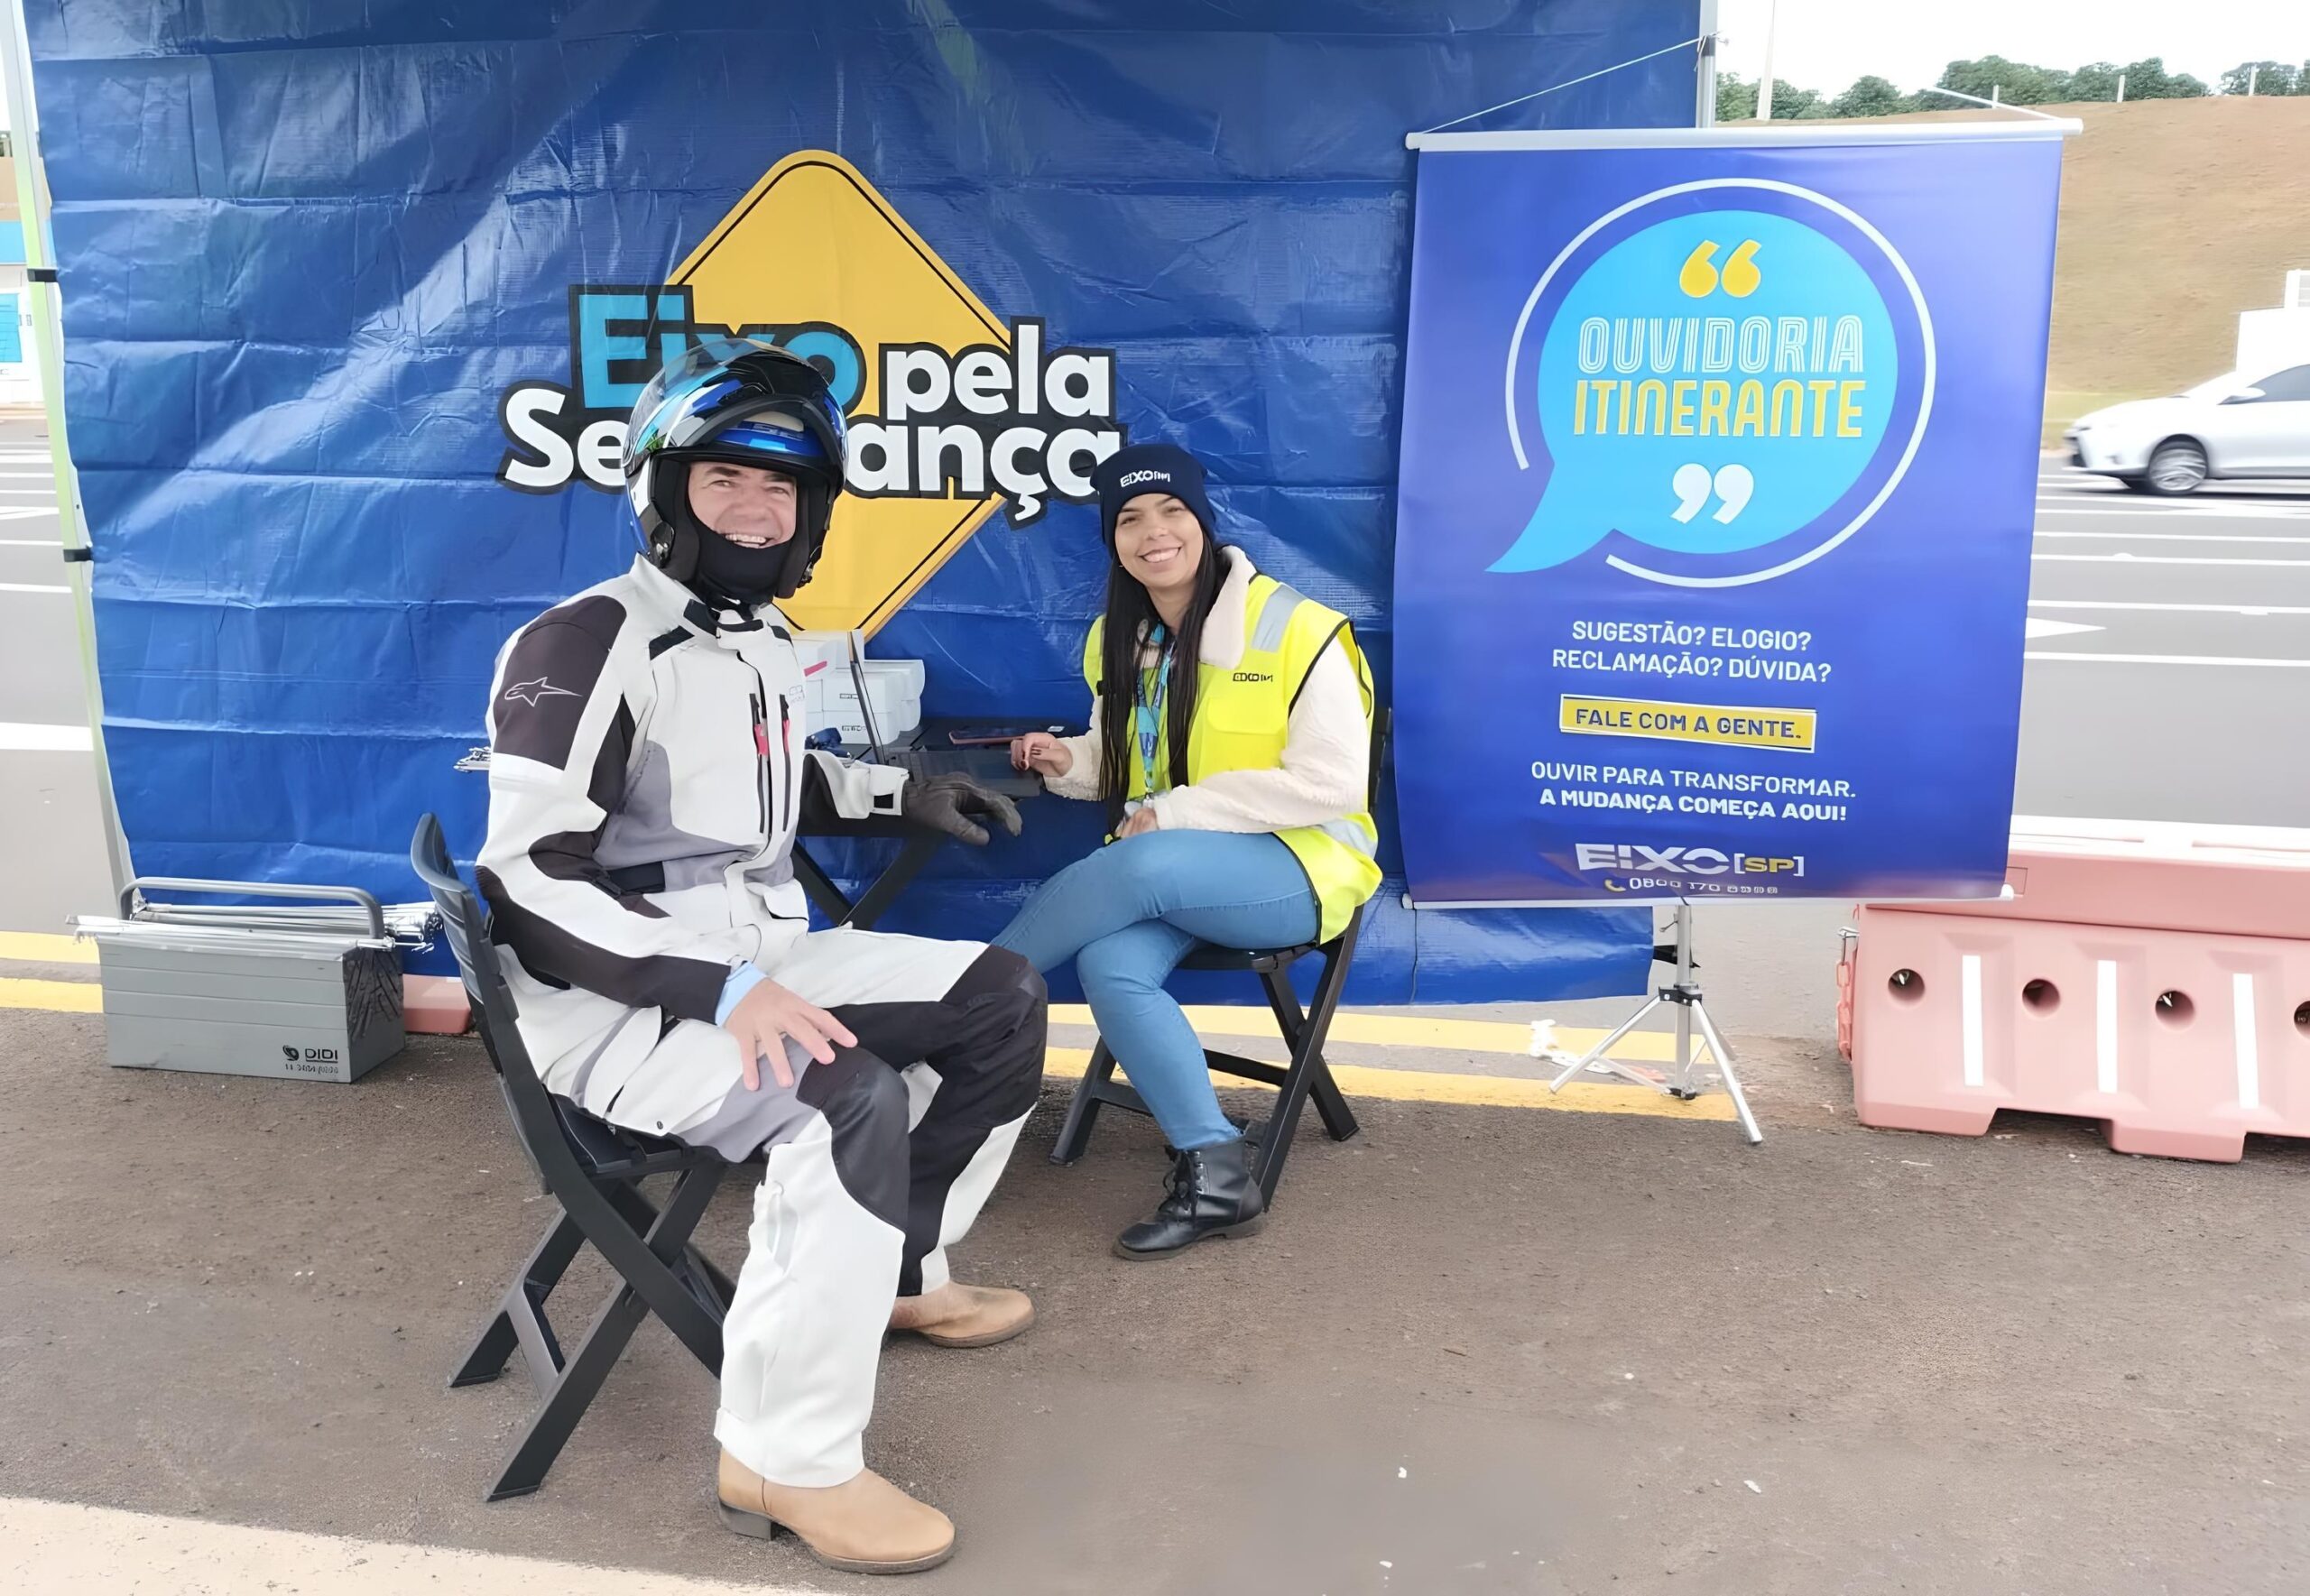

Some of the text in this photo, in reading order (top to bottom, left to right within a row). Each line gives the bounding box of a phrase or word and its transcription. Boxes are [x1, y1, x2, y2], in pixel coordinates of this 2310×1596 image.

[1577, 315, 1864, 374] OUVIDORIA
[886, 323, 1111, 419] pela
[1574, 379, 1867, 438] ITINERANTE
[504, 388, 1121, 521] Seança
[1572, 621, 1812, 651] SUGESTÃO? ELOGIO?
[1552, 650, 1833, 683] RECLAMAÇÃO? DÚVIDA?
[1575, 708, 1802, 739] FALE COM A GENTE.
[1531, 761, 1857, 798] OUVIR PARA TRANSFORMAR.
[1539, 789, 1847, 821] A MUDANÇA COMEÇA AQUI!
[1575, 843, 1731, 875] EIXO
[305, 1048, 338, 1061] DIDI
